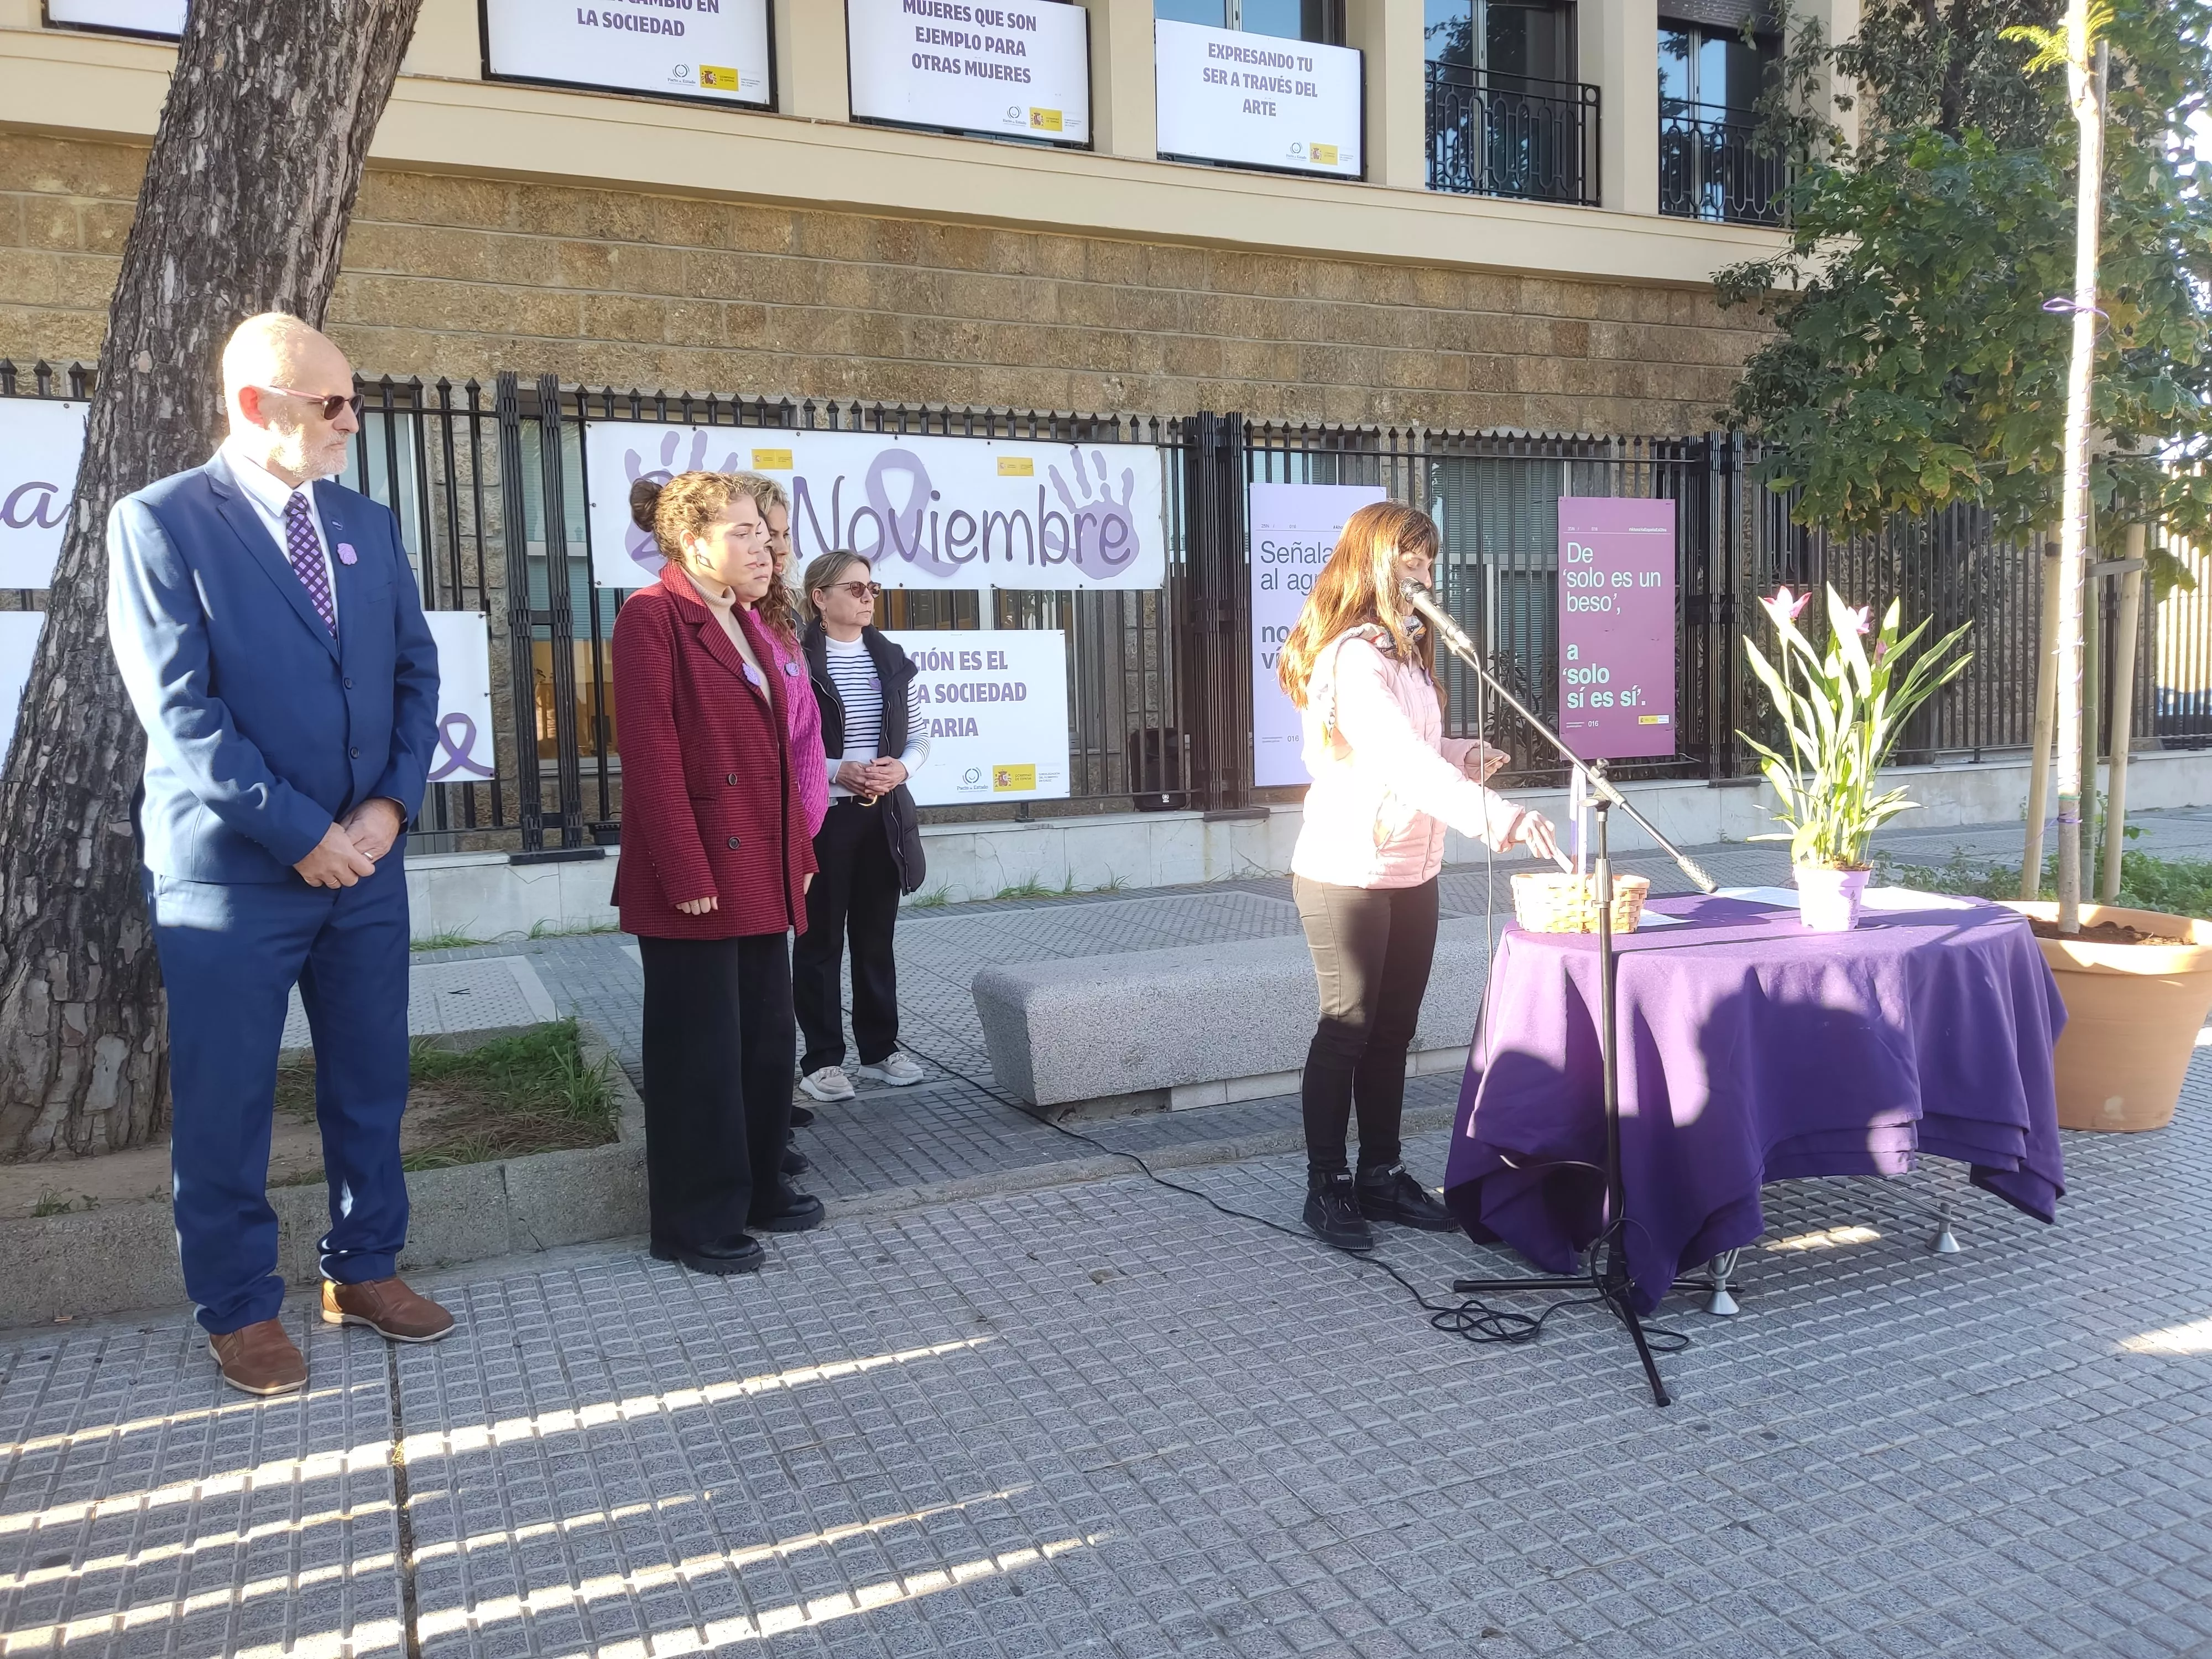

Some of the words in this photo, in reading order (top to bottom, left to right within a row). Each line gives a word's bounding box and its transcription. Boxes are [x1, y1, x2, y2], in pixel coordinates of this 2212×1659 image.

[697, 0, 719, 13] EN
[903, 0, 972, 22] MUJERES
[975, 8, 1004, 28] QUE
[1007, 13, 1037, 32] SON
[577, 8, 598, 26] LA
[602, 11, 685, 36] SOCIEDAD
[915, 26, 982, 50] EJEMPLO
[985, 36, 1026, 56] PARA
[912, 53, 961, 74] OTRAS
[964, 60, 1031, 84] MUJERES
[1208, 42, 1295, 70] EXPRESANDO
[1297, 56, 1313, 72] TU
[1203, 67, 1228, 86] SER
[1230, 71, 1240, 87] A
[1243, 73, 1292, 94] TRAVÉS
[1295, 81, 1318, 98] DEL
[1243, 98, 1276, 117] ARTE
[792, 475, 1130, 567] Noviembre
[1261, 540, 1333, 564] Señala
[1567, 542, 1593, 564] De
[1261, 567, 1278, 590] al
[1287, 573, 1317, 596] ag
[1611, 571, 1632, 587] es
[1639, 571, 1661, 587] un
[1262, 625, 1290, 643] no
[905, 647, 954, 671] CIÓN
[959, 651, 982, 670] ES
[987, 650, 1008, 670] EL
[1567, 644, 1579, 660] a
[917, 684, 931, 704] A
[935, 682, 1027, 703] SOCIEDAD
[1567, 686, 1586, 708] sí
[1590, 691, 1614, 708] es
